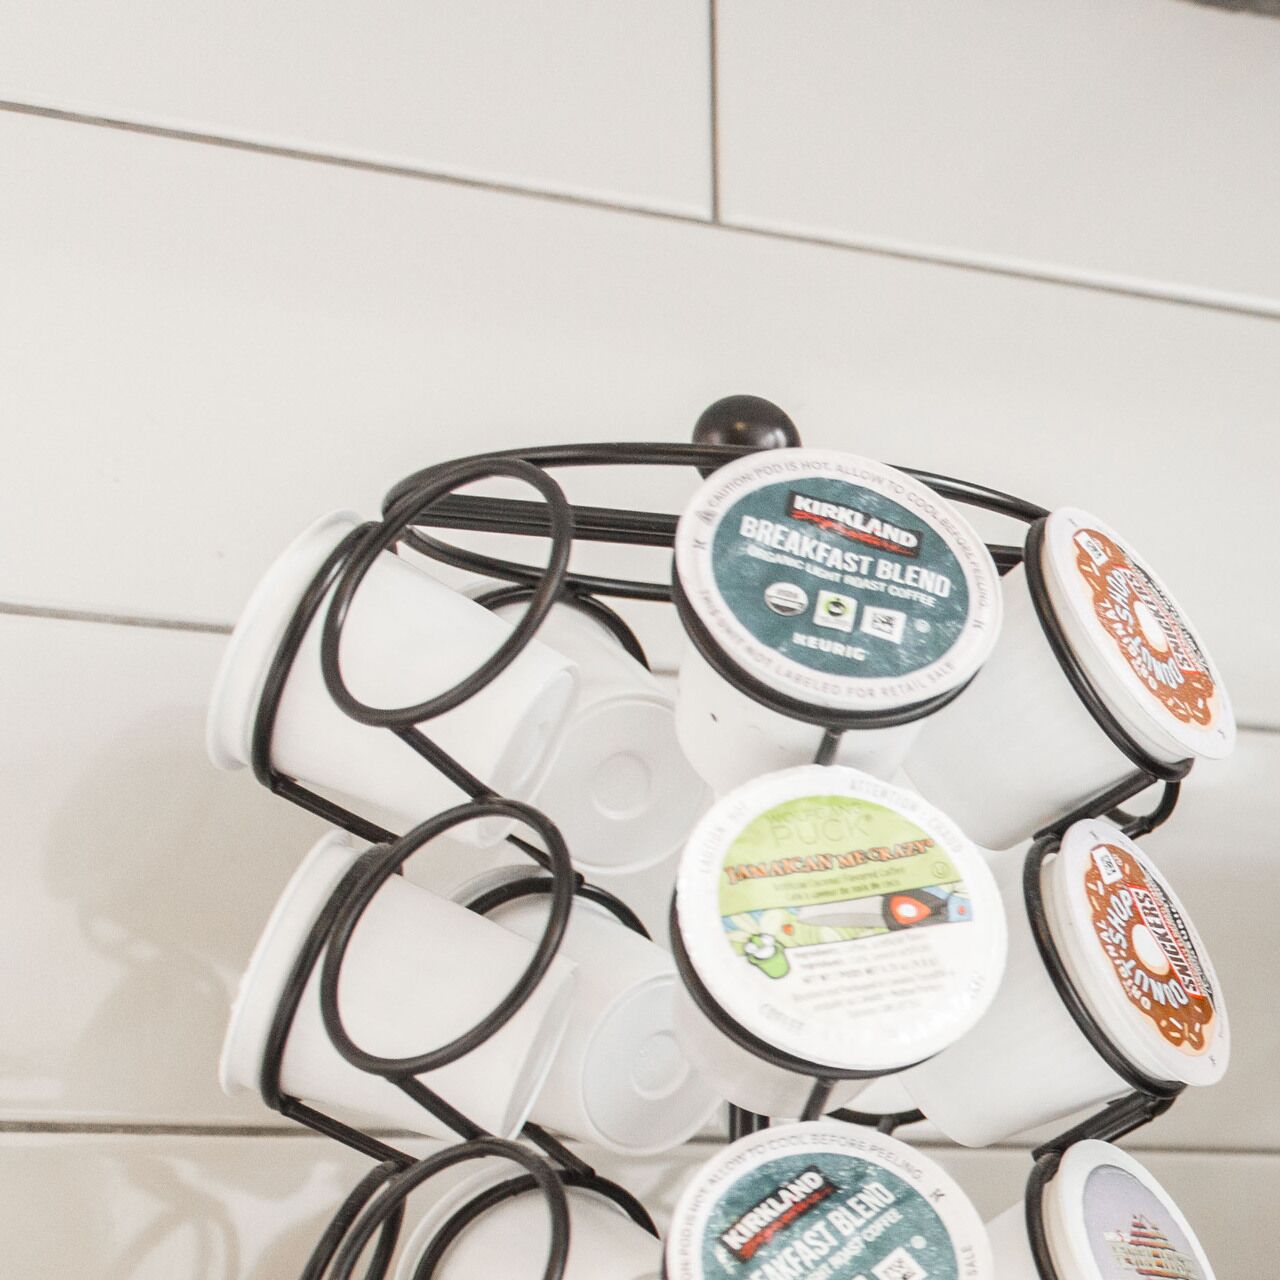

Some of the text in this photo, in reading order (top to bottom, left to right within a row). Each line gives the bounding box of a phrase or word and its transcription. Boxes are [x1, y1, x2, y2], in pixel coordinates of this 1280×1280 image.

[792, 494, 919, 549] KIRKLAND
[740, 514, 951, 599] BREAKFAST BLEND
[886, 585, 937, 609] COFFEE
[1121, 569, 1194, 672] SNICKERS
[791, 632, 866, 662] KEURIG
[724, 852, 834, 886] JAMAICAN
[836, 849, 867, 870] ME
[1106, 888, 1135, 950] SHOP
[1133, 889, 1199, 995] SNICKERS
[1097, 919, 1152, 1011] ORIGINAL
[722, 1171, 824, 1250] KIRKLAND
[826, 1181, 897, 1237] BLEND
